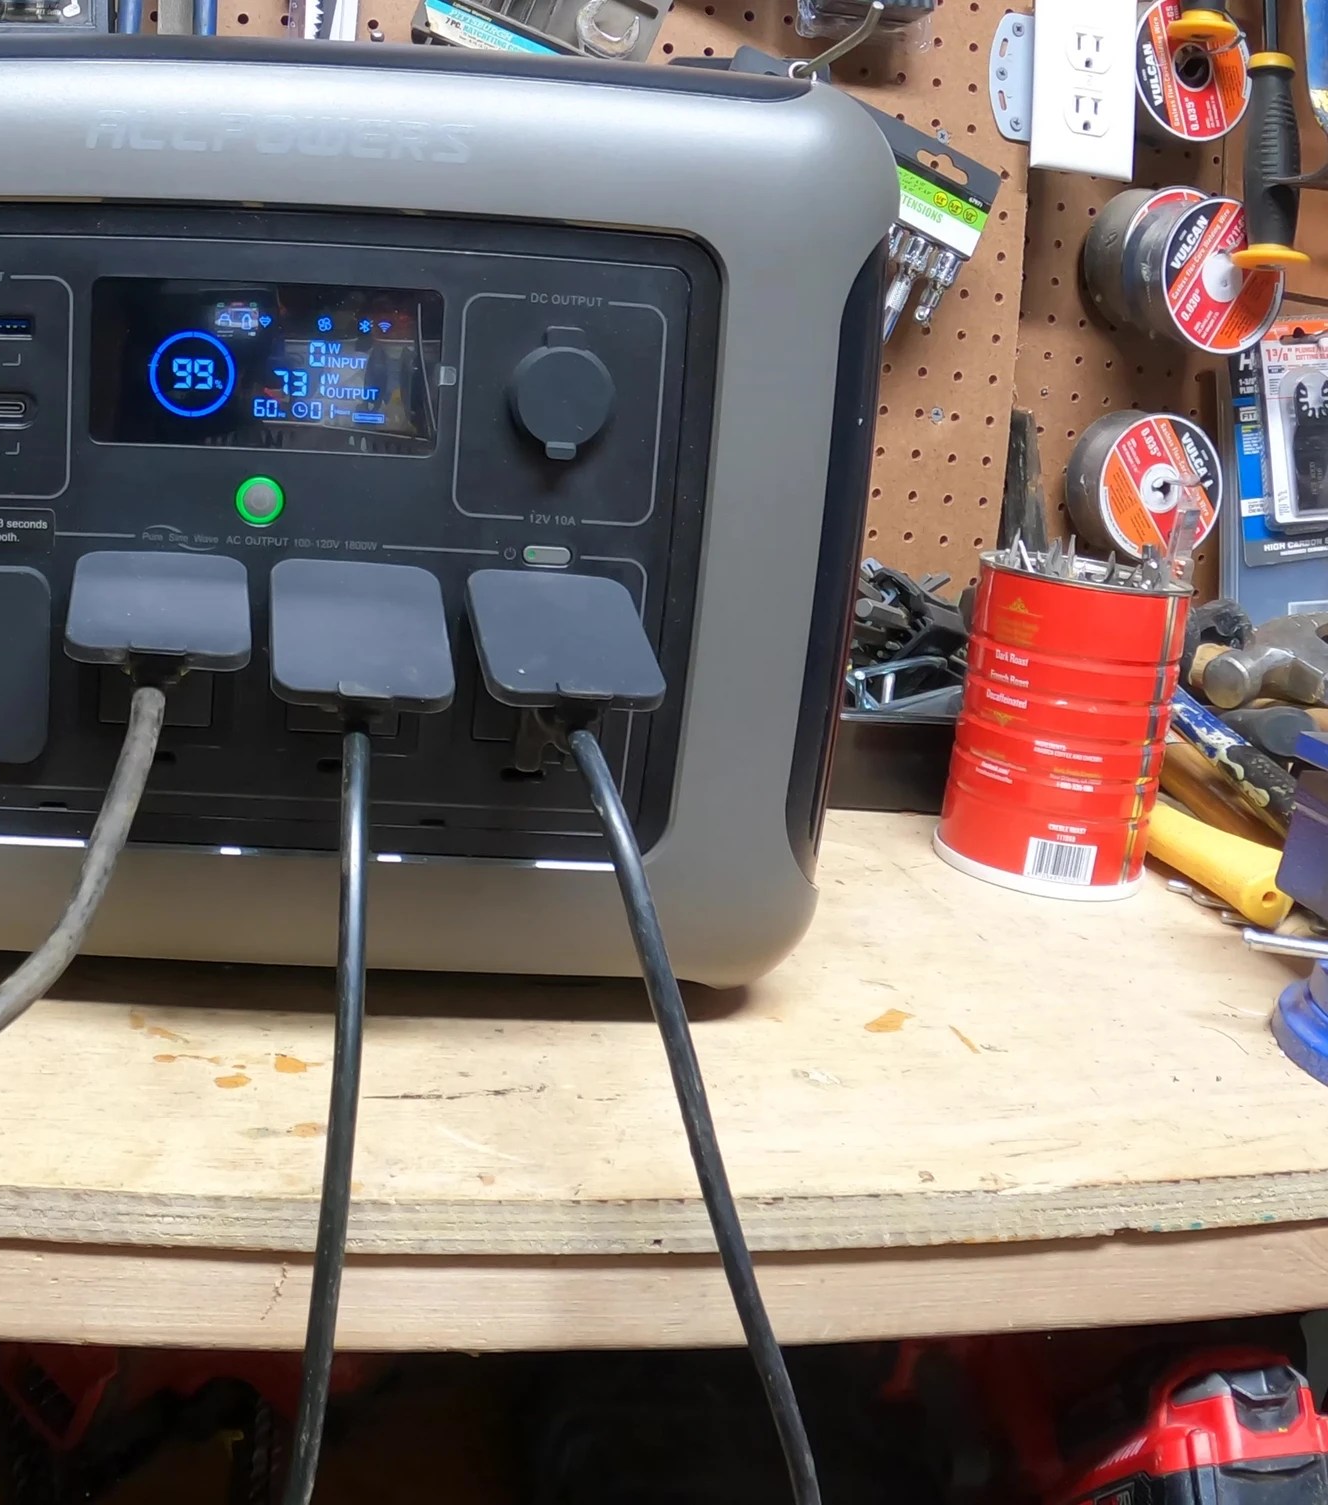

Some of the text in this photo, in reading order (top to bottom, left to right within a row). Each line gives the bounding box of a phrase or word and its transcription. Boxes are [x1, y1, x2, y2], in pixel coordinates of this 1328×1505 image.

[1151, 16, 1160, 33] Wire
[1141, 42, 1164, 105] VULCAN
[85, 109, 475, 164] ALLPOWERS
[901, 193, 944, 224] TENSIONS
[1169, 213, 1211, 270] VULCAN
[530, 292, 603, 307] DC OUTPUT
[309, 341, 341, 367] 0 W
[328, 357, 367, 370] INPUT
[326, 373, 340, 385] W
[327, 387, 379, 400] OUTPUT
[6, 518, 48, 529] seconds
[529, 513, 576, 526] 12V 10A
[194, 534, 219, 544] Wave
[226, 535, 241, 545] AC
[245, 536, 290, 547] OUTPUT
[294, 538, 340, 549] 100-120V
[344, 540, 378, 551] 1800W
[1264, 542, 1286, 552] HIGH
[1287, 538, 1322, 549] CARBON
[995, 649, 1029, 667] Dark Roast
[1010, 674, 1029, 688] Roast
[986, 688, 1028, 709] Decaffeinated
